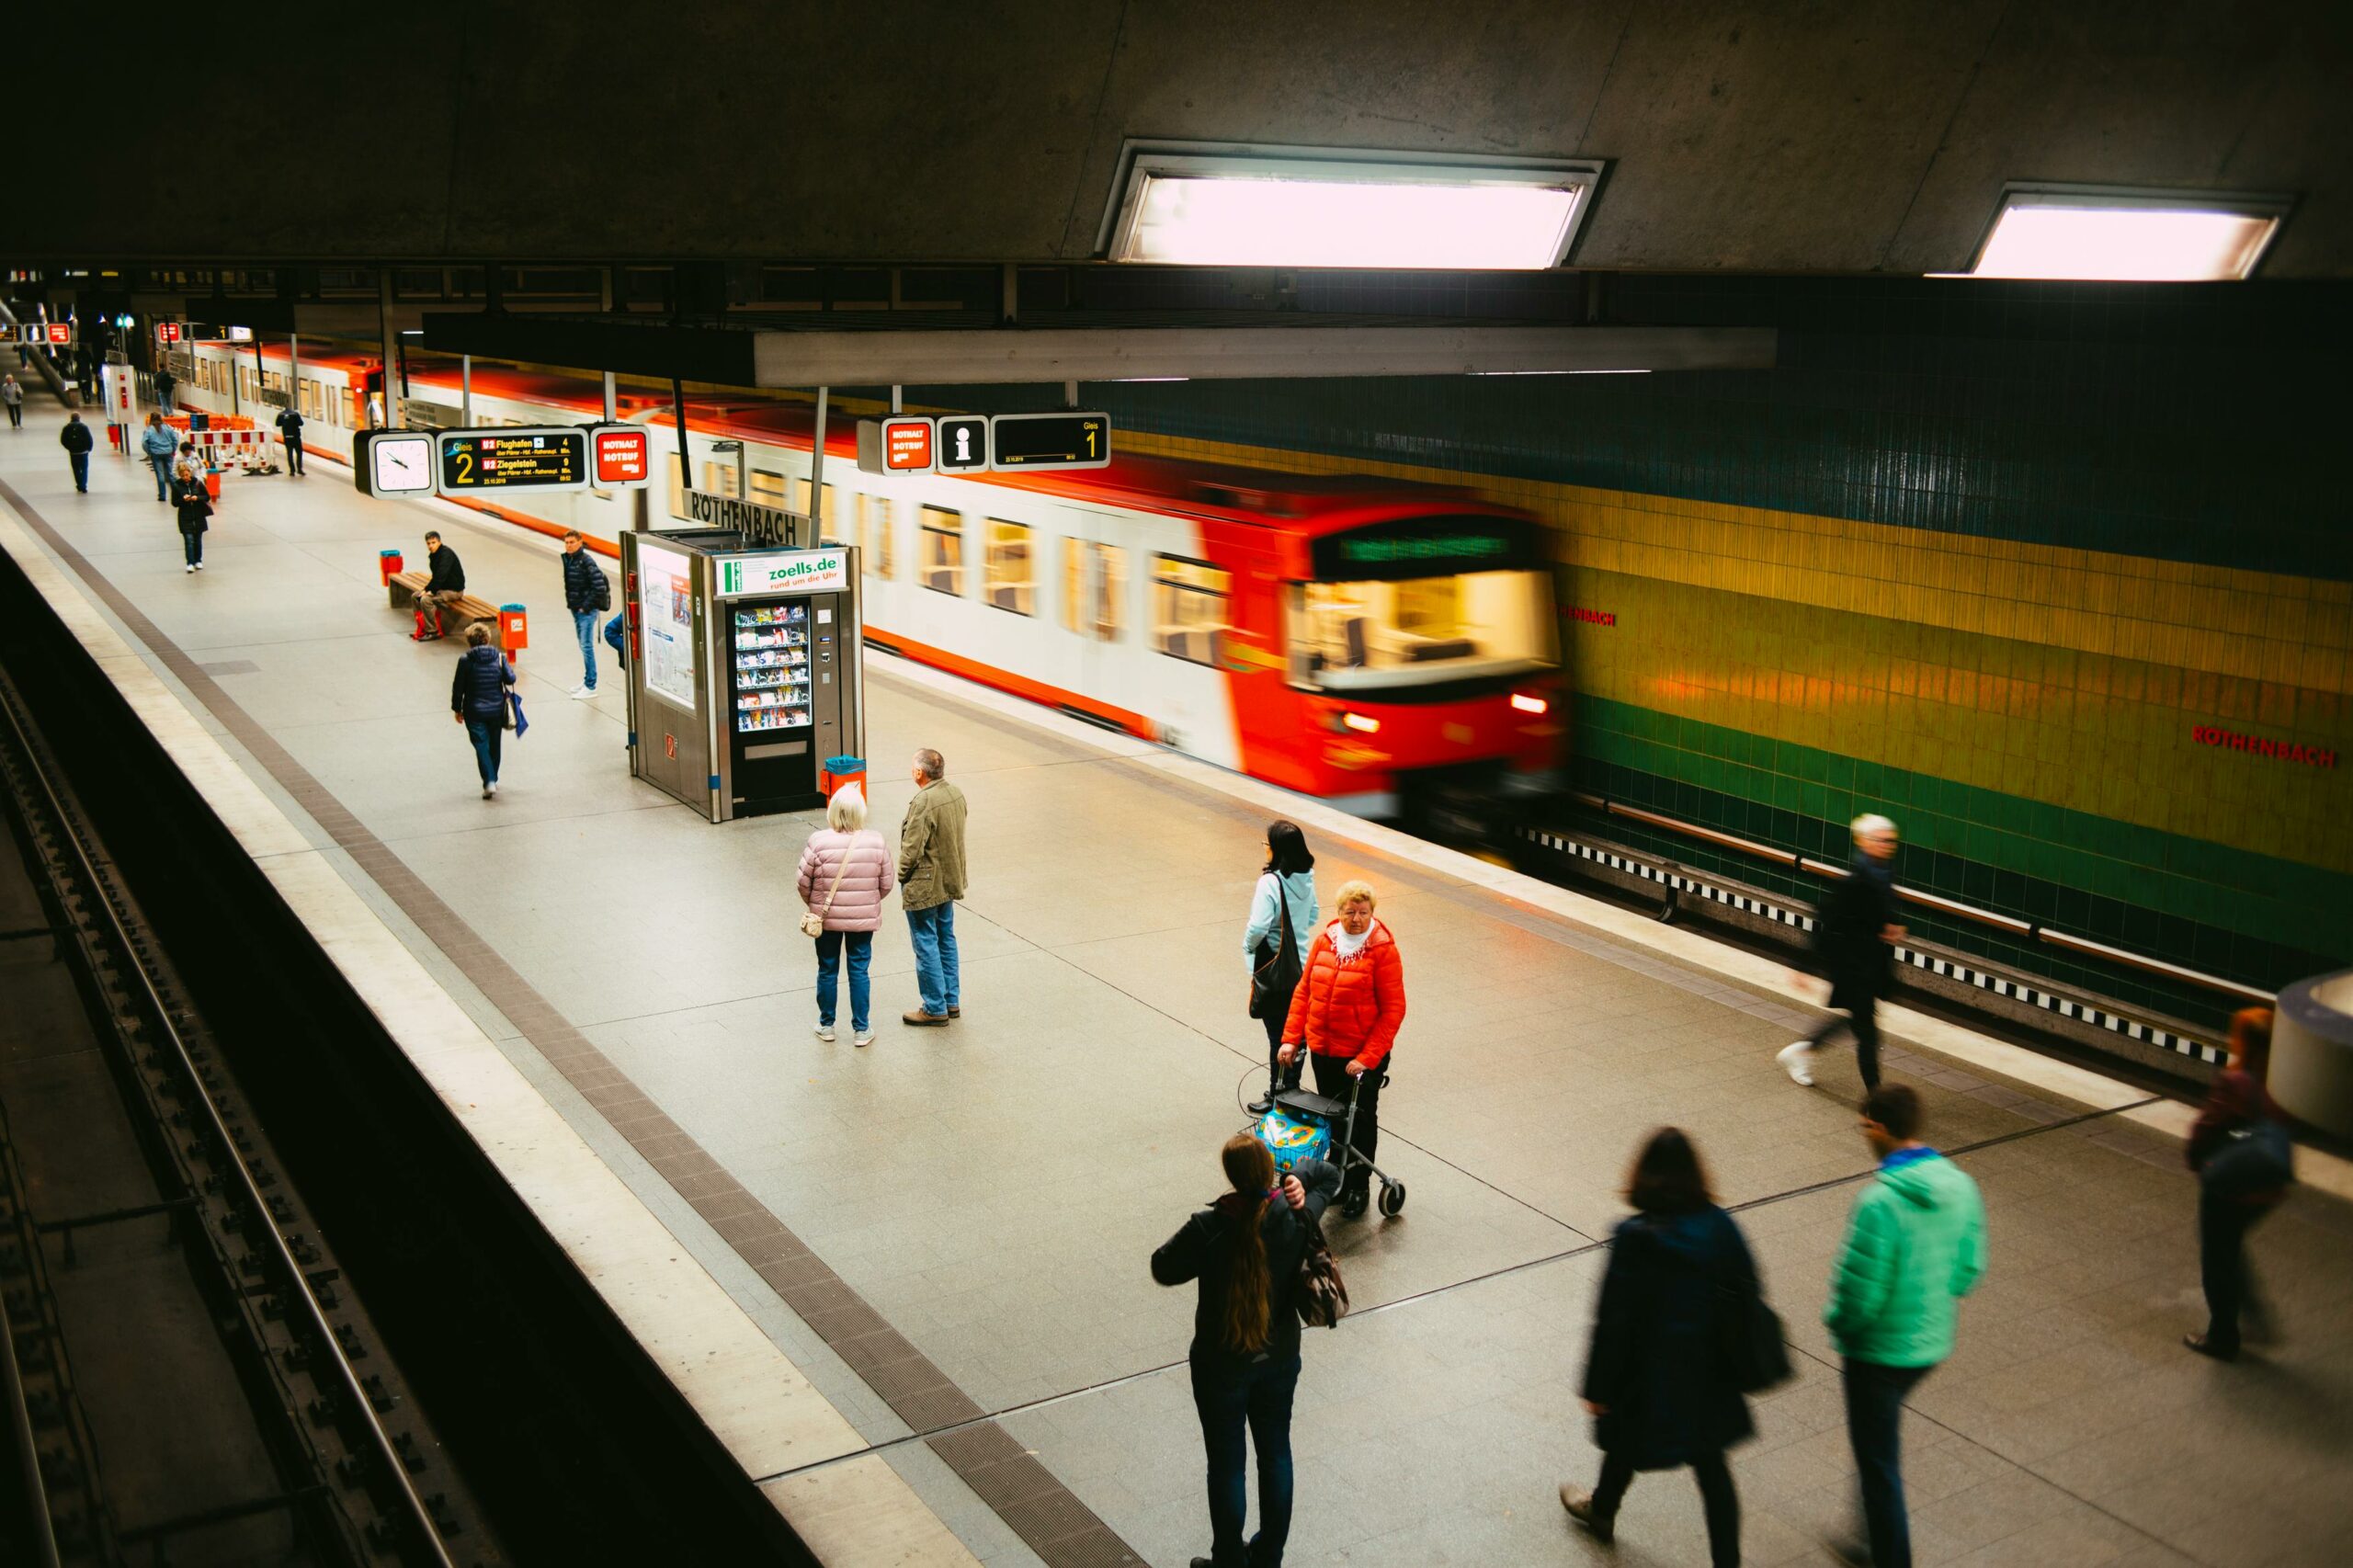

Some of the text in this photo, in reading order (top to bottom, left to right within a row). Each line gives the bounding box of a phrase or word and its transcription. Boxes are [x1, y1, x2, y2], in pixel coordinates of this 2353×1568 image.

[1084, 422, 1098, 430] Gleis
[892, 430, 924, 439] NOTHALT
[453, 442, 472, 451] Gleis
[483, 437, 568, 450] U2 Flughafen 4
[603, 439, 639, 450] NOTHALT
[892, 442, 924, 450] NOTRUF
[1086, 431, 1096, 458] 1
[604, 452, 639, 461] NOTRUF
[456, 453, 474, 484] 2
[483, 458, 569, 471] U2 Ziegelstein 9
[692, 492, 796, 546] RÖTHENBACH
[769, 558, 836, 581] zoells.de
[770, 579, 790, 590] rund
[807, 574, 821, 583] die
[823, 571, 838, 580] Uhr
